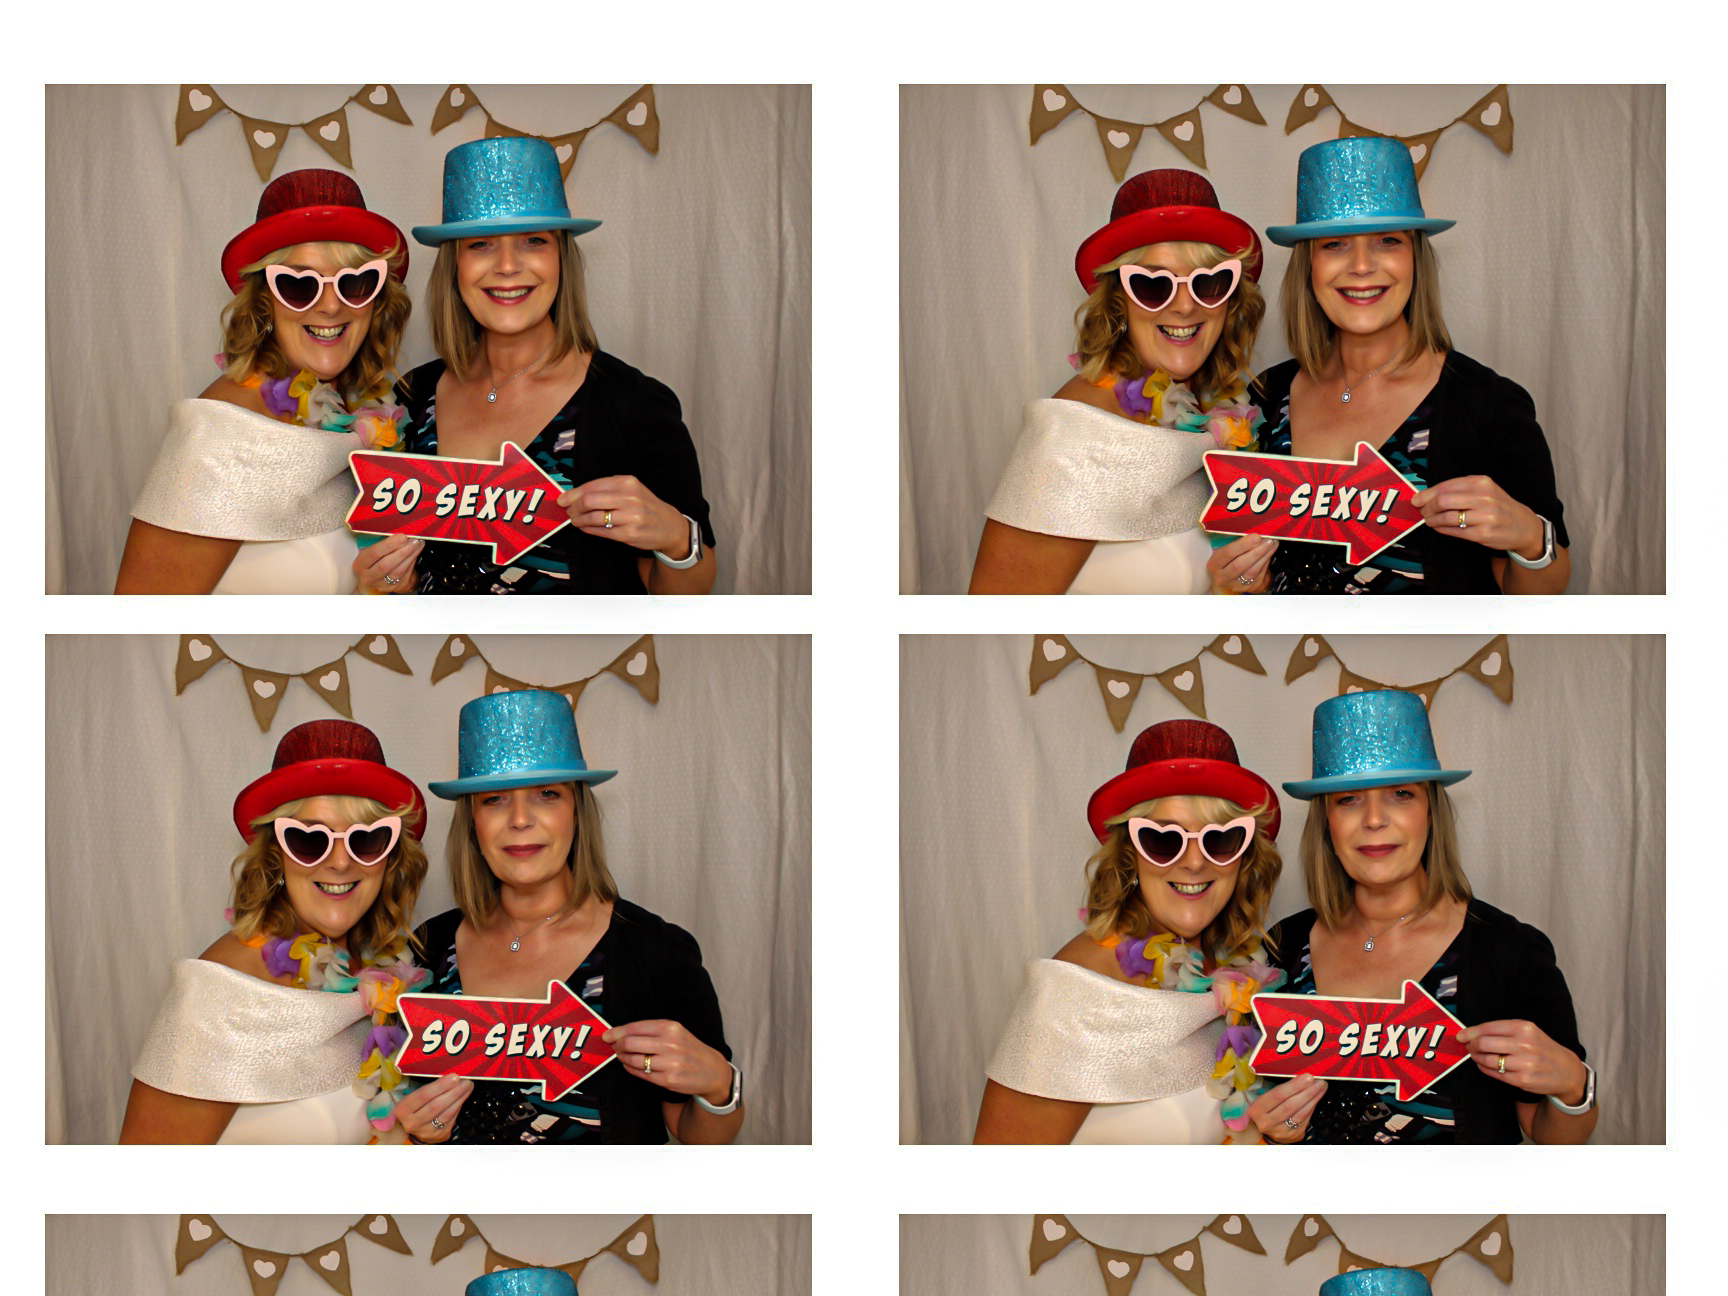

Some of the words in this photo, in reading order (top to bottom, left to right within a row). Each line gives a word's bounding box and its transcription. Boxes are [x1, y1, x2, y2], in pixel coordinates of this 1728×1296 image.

[372, 478, 422, 514] SO
[435, 483, 546, 525] SEXY!
[1226, 478, 1276, 514] SO
[1289, 483, 1400, 525] SEXY!
[421, 1019, 471, 1055] SO
[484, 1022, 593, 1060] SEXY!
[1275, 1019, 1325, 1055] SO
[1338, 1022, 1447, 1060] SEXY!
